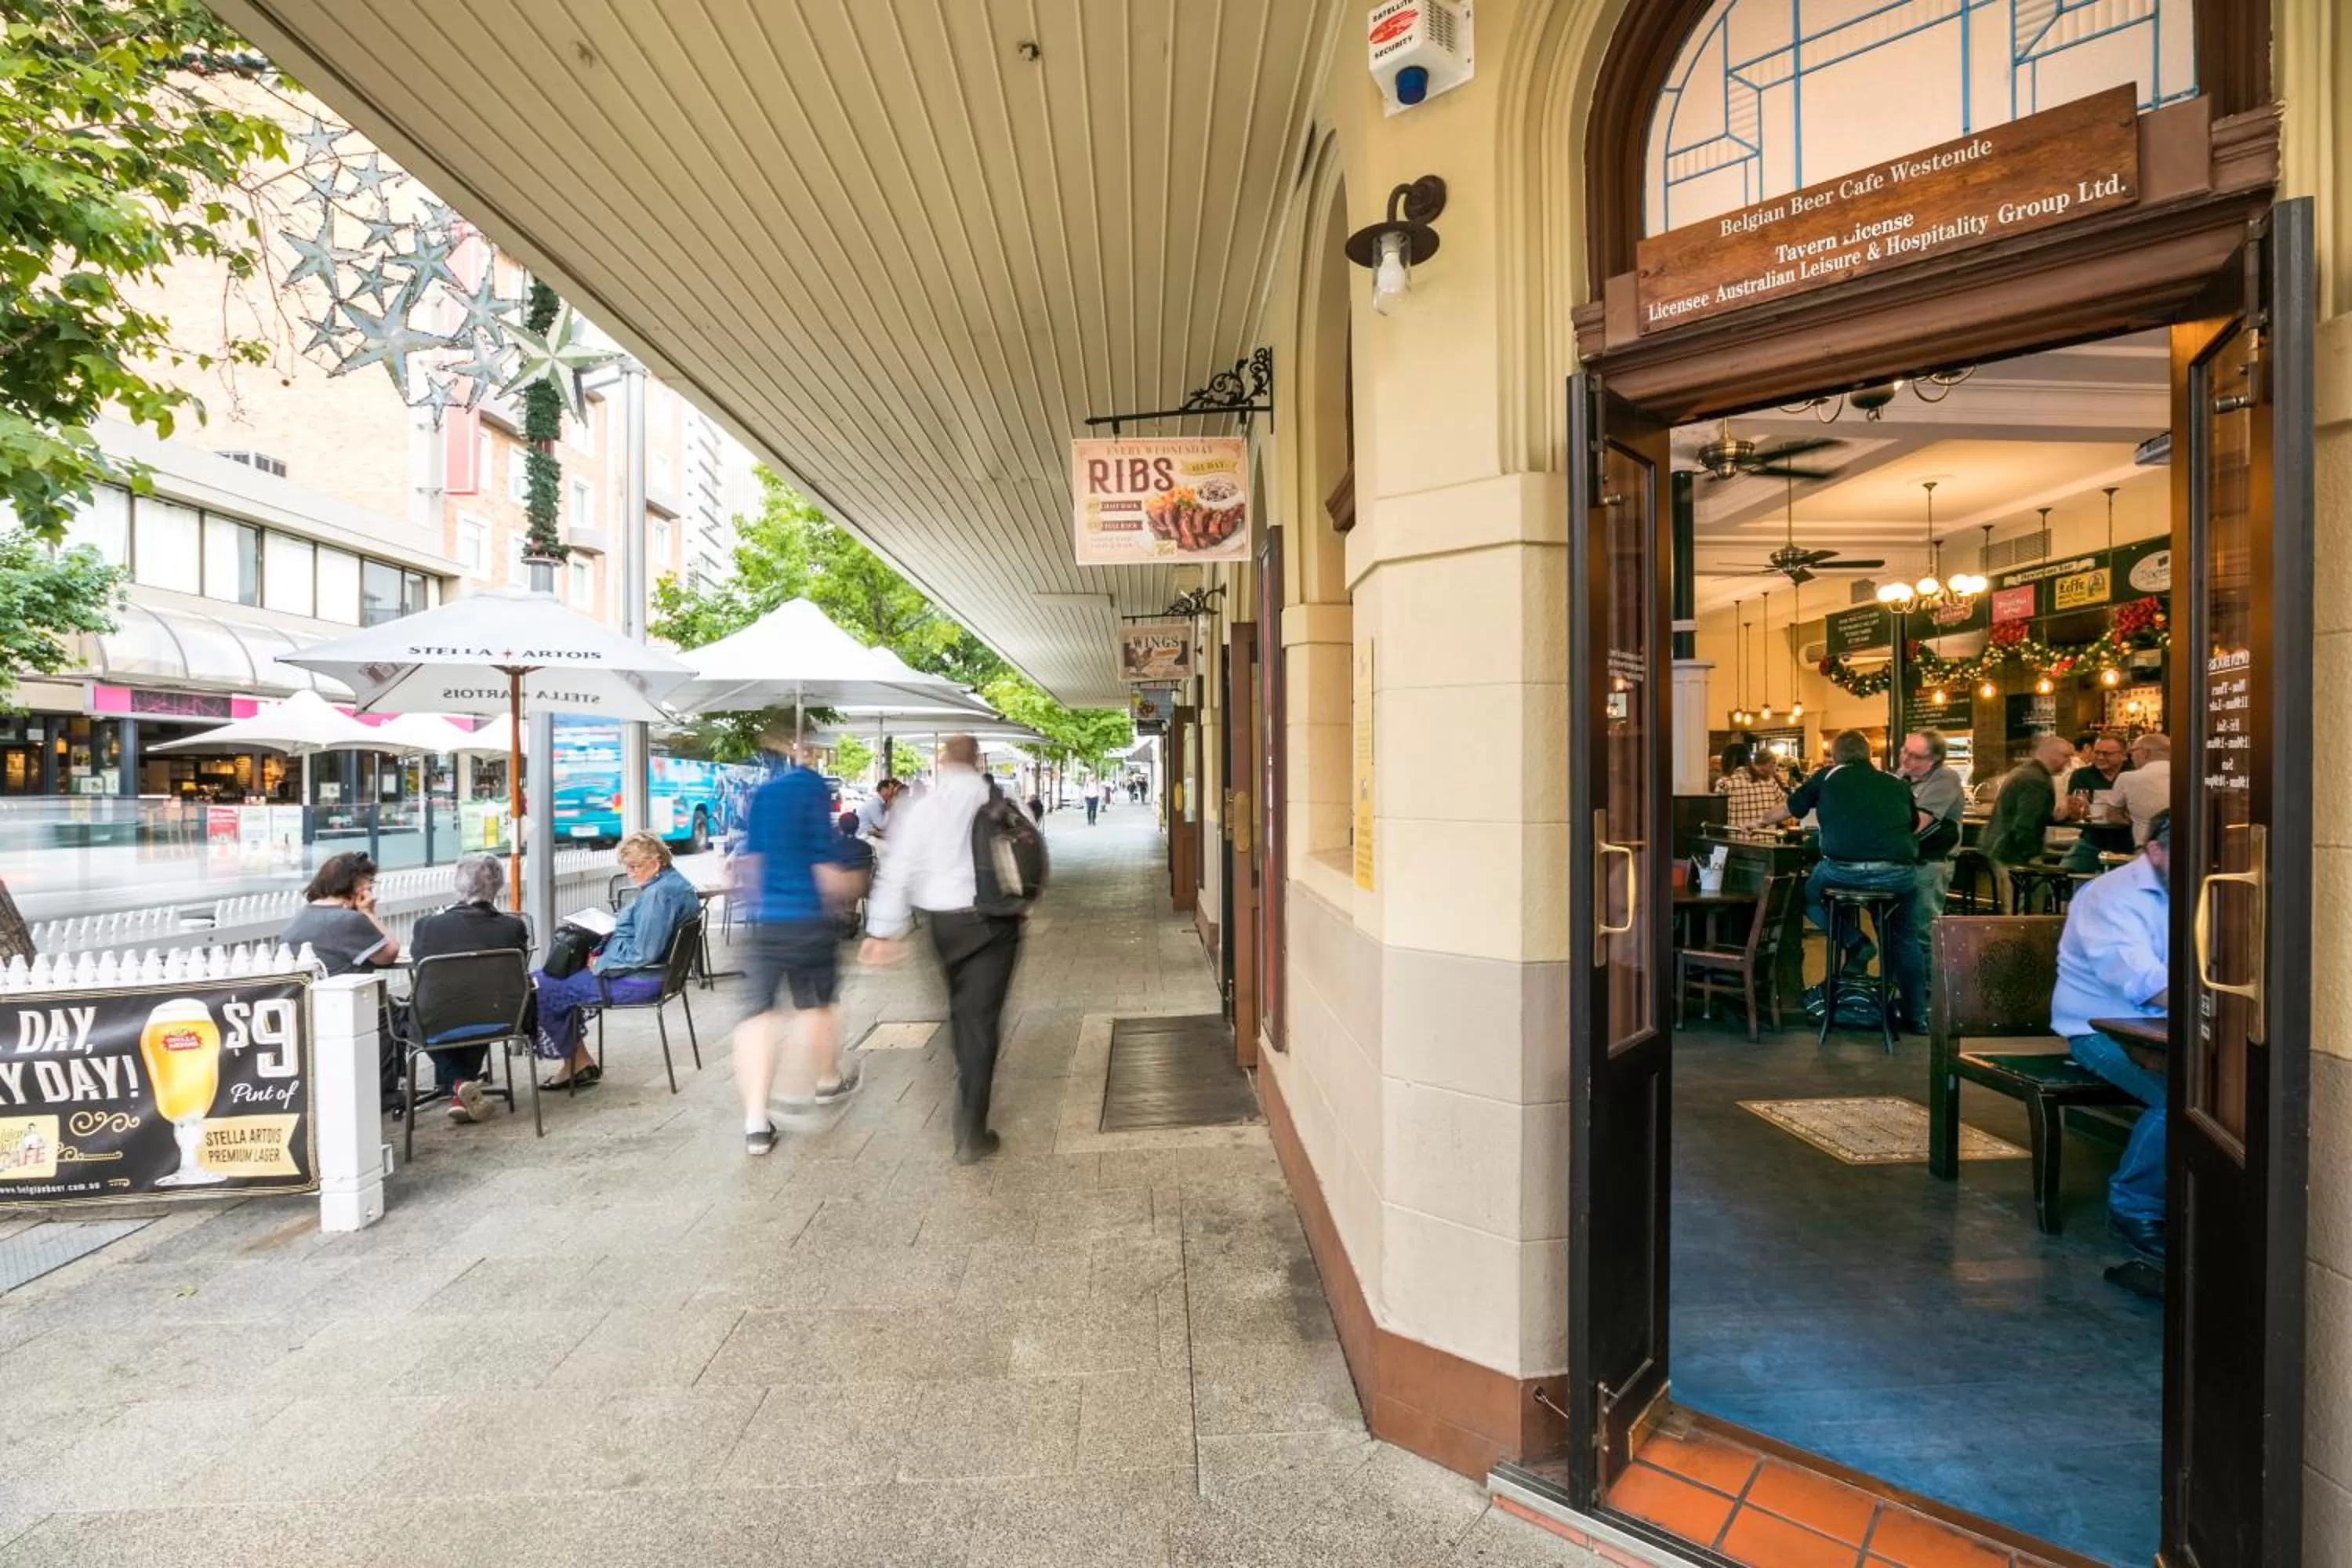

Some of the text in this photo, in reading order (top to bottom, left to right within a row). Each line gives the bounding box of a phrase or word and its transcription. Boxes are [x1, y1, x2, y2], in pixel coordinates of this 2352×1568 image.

[1374, 34, 1413, 59] SECURITY
[1720, 140, 1992, 238] Belgian Beer Cafe Westende
[1648, 173, 2127, 321] Licensee Australian Leisure & Hospitality Group Ltd.
[1775, 235, 1837, 264] Tavern
[1087, 457, 1175, 494] RIBS
[408, 646, 601, 659] STELLA ARTOIS
[1132, 635, 1180, 648] WINGS
[14, 1007, 98, 1054] DAY,
[223, 995, 298, 1078] $9
[34, 1054, 140, 1103] DAY!
[230, 1080, 299, 1109] Pint of
[205, 1128, 283, 1146] STELLA ARTOIS
[208, 1148, 281, 1163] PREMIUM LAGER
